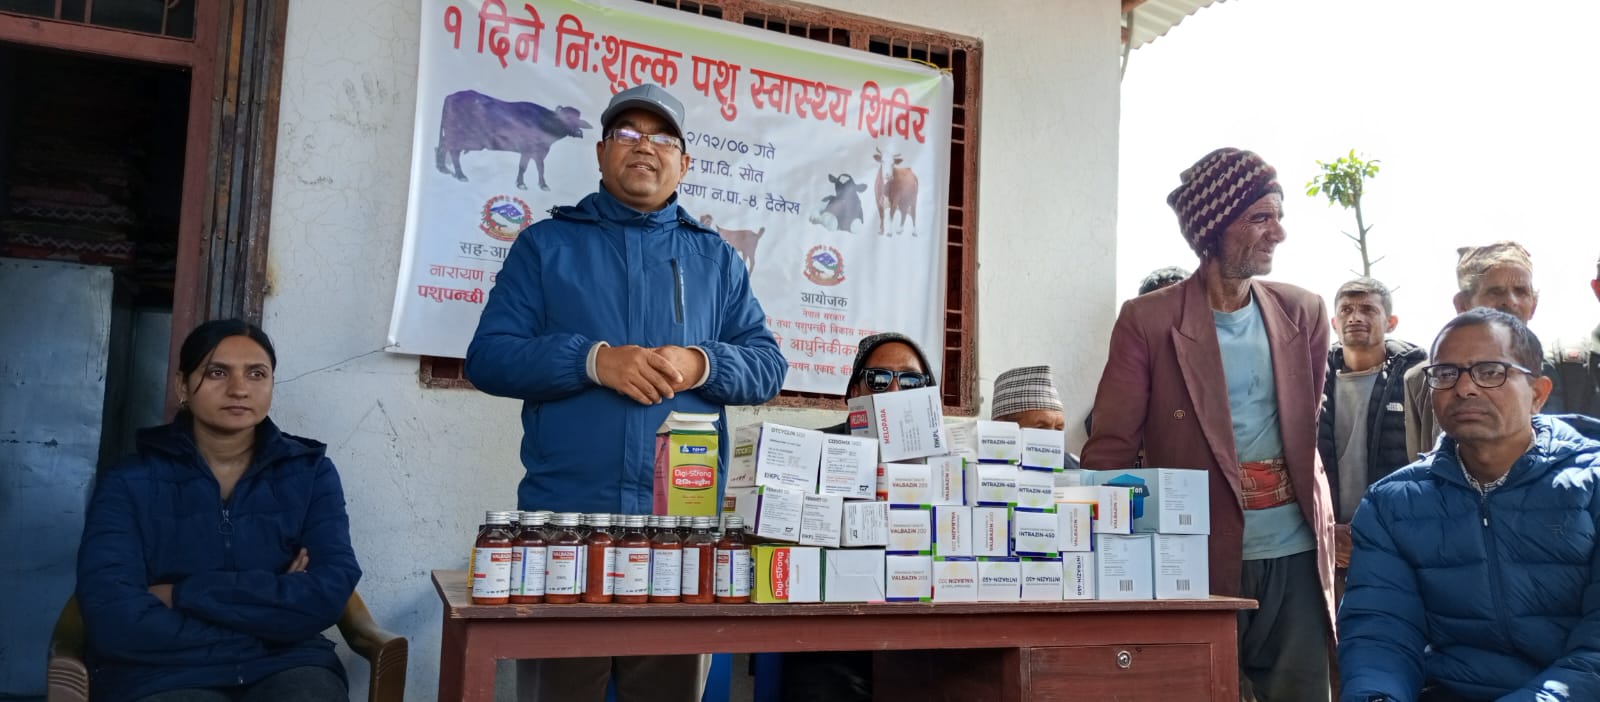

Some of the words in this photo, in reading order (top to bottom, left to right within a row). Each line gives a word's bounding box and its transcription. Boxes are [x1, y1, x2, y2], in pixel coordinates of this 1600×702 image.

[444, 5, 462, 49] १
[478, 0, 545, 69] दिने
[692, 55, 741, 122] पशु
[750, 68, 852, 127] स्वास्थ्य
[858, 80, 929, 144] शिविर
[753, 142, 776, 160] गते
[739, 163, 765, 183] सोत
[765, 192, 801, 215] दैलेख
[429, 264, 485, 282] नारायण
[801, 291, 849, 308] आयोजक
[776, 318, 791, 328] तथा
[790, 336, 858, 358] आधुनिकीकर
